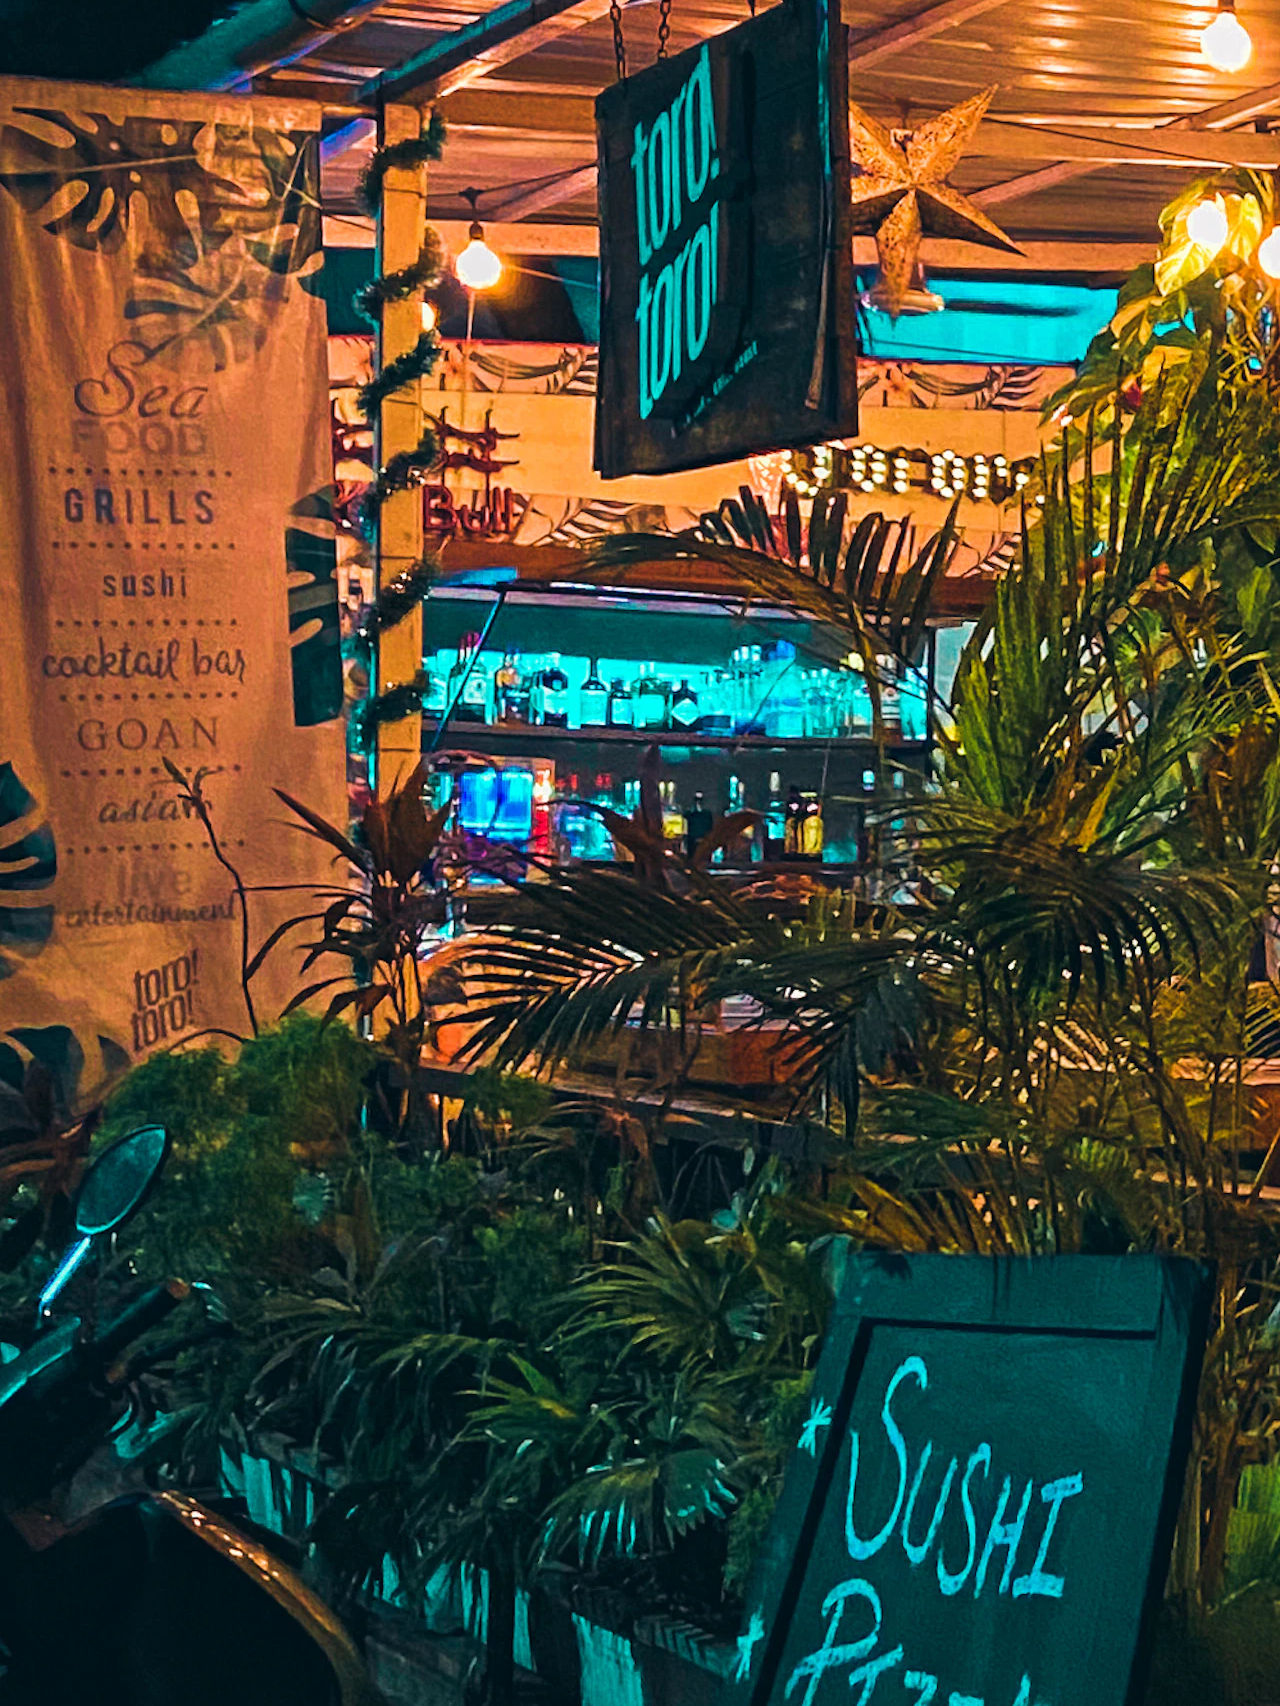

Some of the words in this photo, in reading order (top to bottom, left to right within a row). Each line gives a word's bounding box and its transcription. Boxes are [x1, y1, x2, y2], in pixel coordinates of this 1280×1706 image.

[73, 332, 209, 419] Sea
[71, 419, 209, 457] FOOD
[64, 487, 215, 525] GRILLS
[102, 567, 188, 598] sushi
[41, 635, 180, 683] cocktail
[192, 635, 246, 684] bar
[77, 715, 218, 752] GOAN
[99, 790, 213, 824] asian
[65, 891, 237, 928] entertainment
[133, 946, 200, 1013] toro!
[130, 988, 196, 1053] toro!
[844, 1355, 1084, 1599] SUSHI
